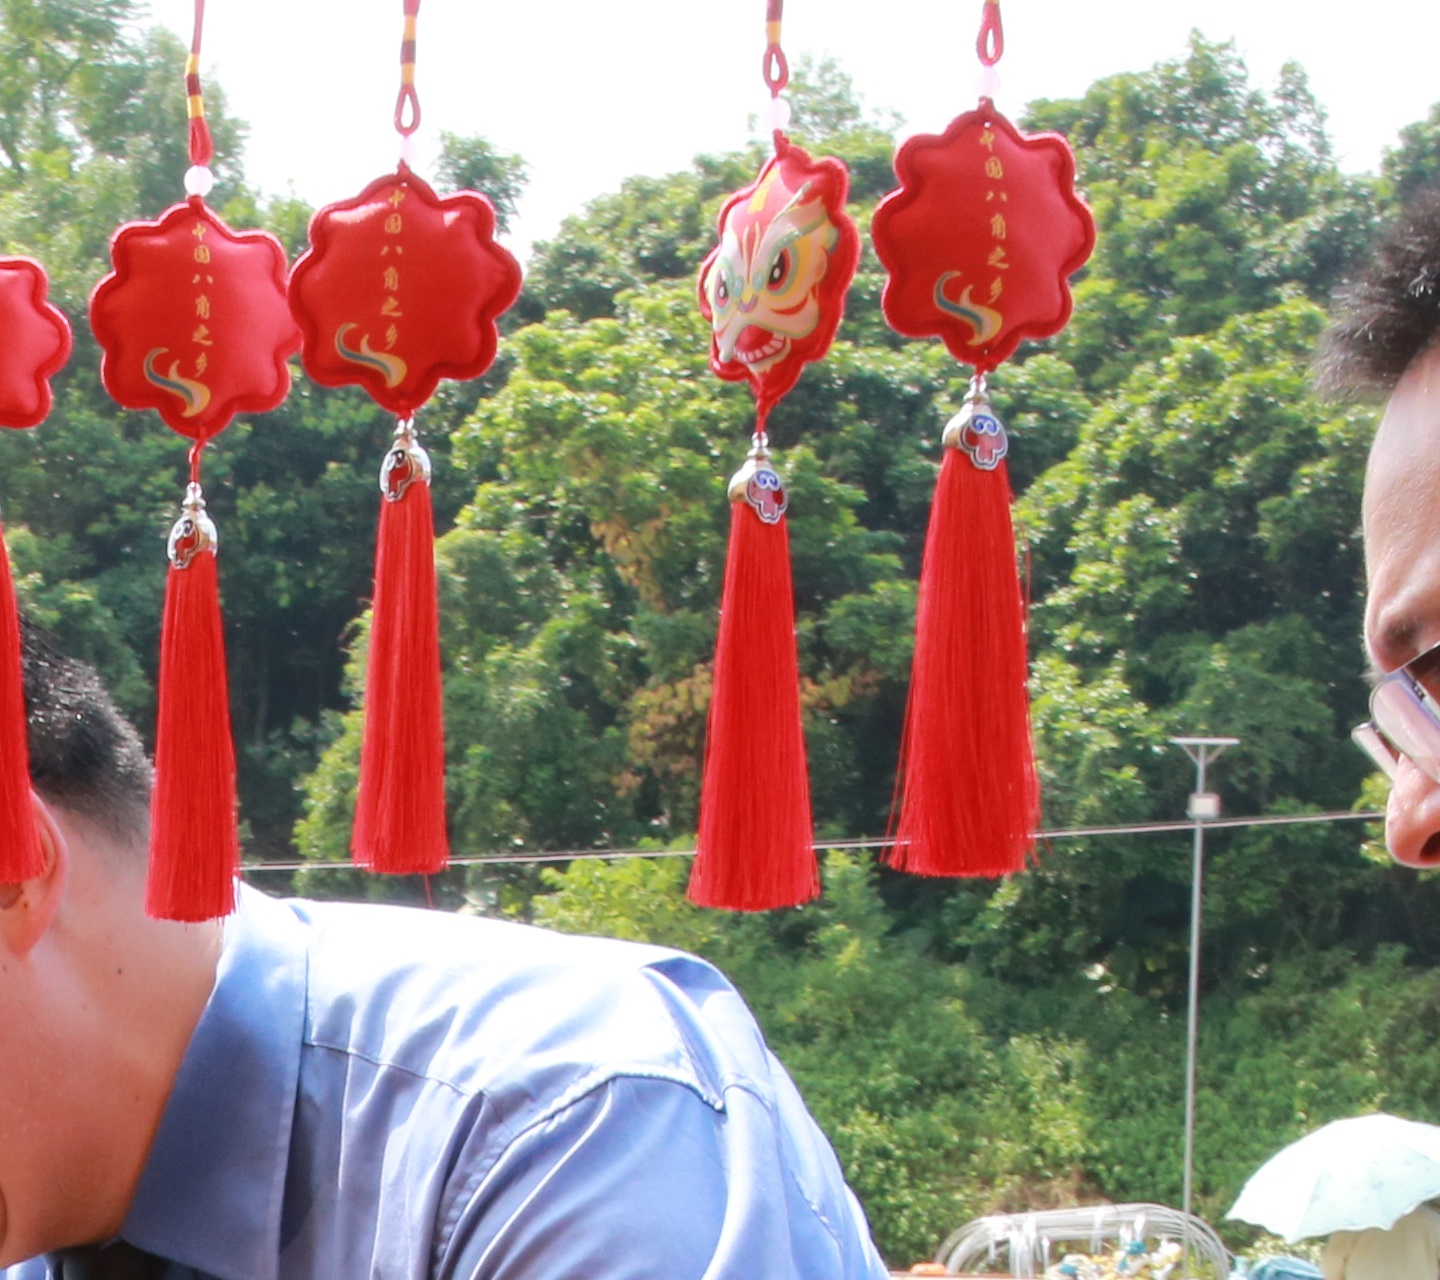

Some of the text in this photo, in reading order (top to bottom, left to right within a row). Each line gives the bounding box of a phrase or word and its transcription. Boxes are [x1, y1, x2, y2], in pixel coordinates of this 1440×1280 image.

[380, 190, 406, 350] 中国八角之乡
[979, 129, 1009, 305] 中国八角之乡
[191, 222, 214, 377] 中国八角之乡
